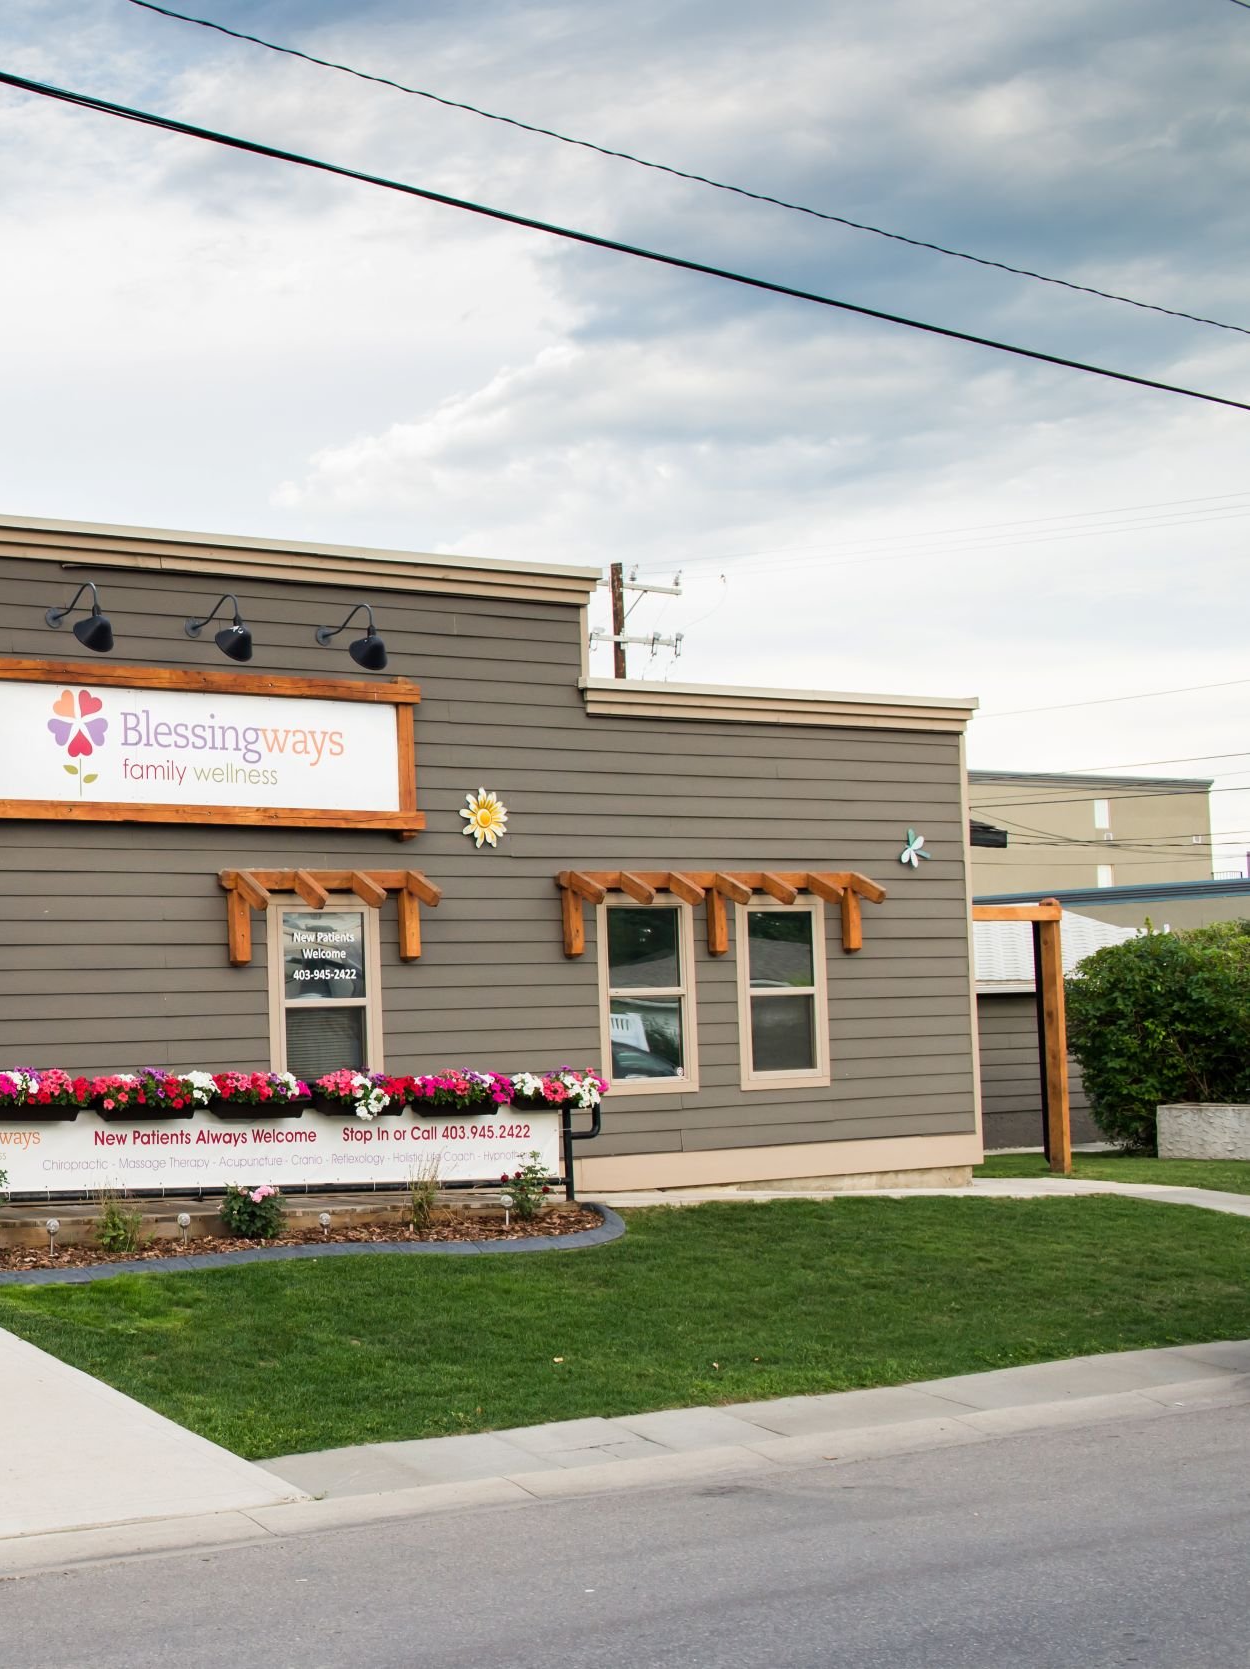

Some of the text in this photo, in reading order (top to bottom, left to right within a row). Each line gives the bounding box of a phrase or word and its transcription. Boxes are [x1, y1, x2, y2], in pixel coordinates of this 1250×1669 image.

[120, 709, 344, 766] Blessingways
[122, 758, 278, 786] family wellness
[293, 932, 355, 942] New Patients
[302, 948, 346, 959] Welcome
[293, 969, 357, 981] 403-945-2422
[94, 1128, 317, 1147] New Patients Always Welcome
[342, 1124, 531, 1144] Stop In or Call 403.945.2422
[42, 1159, 109, 1171] Chiropractic
[118, 1157, 167, 1171] Massage
[169, 1157, 209, 1169] Therapy
[219, 1156, 283, 1168] Acupuncture
[331, 1153, 385, 1166] Reflexology
[392, 1152, 424, 1163] Holistic
[443, 1151, 476, 1162] Coach
